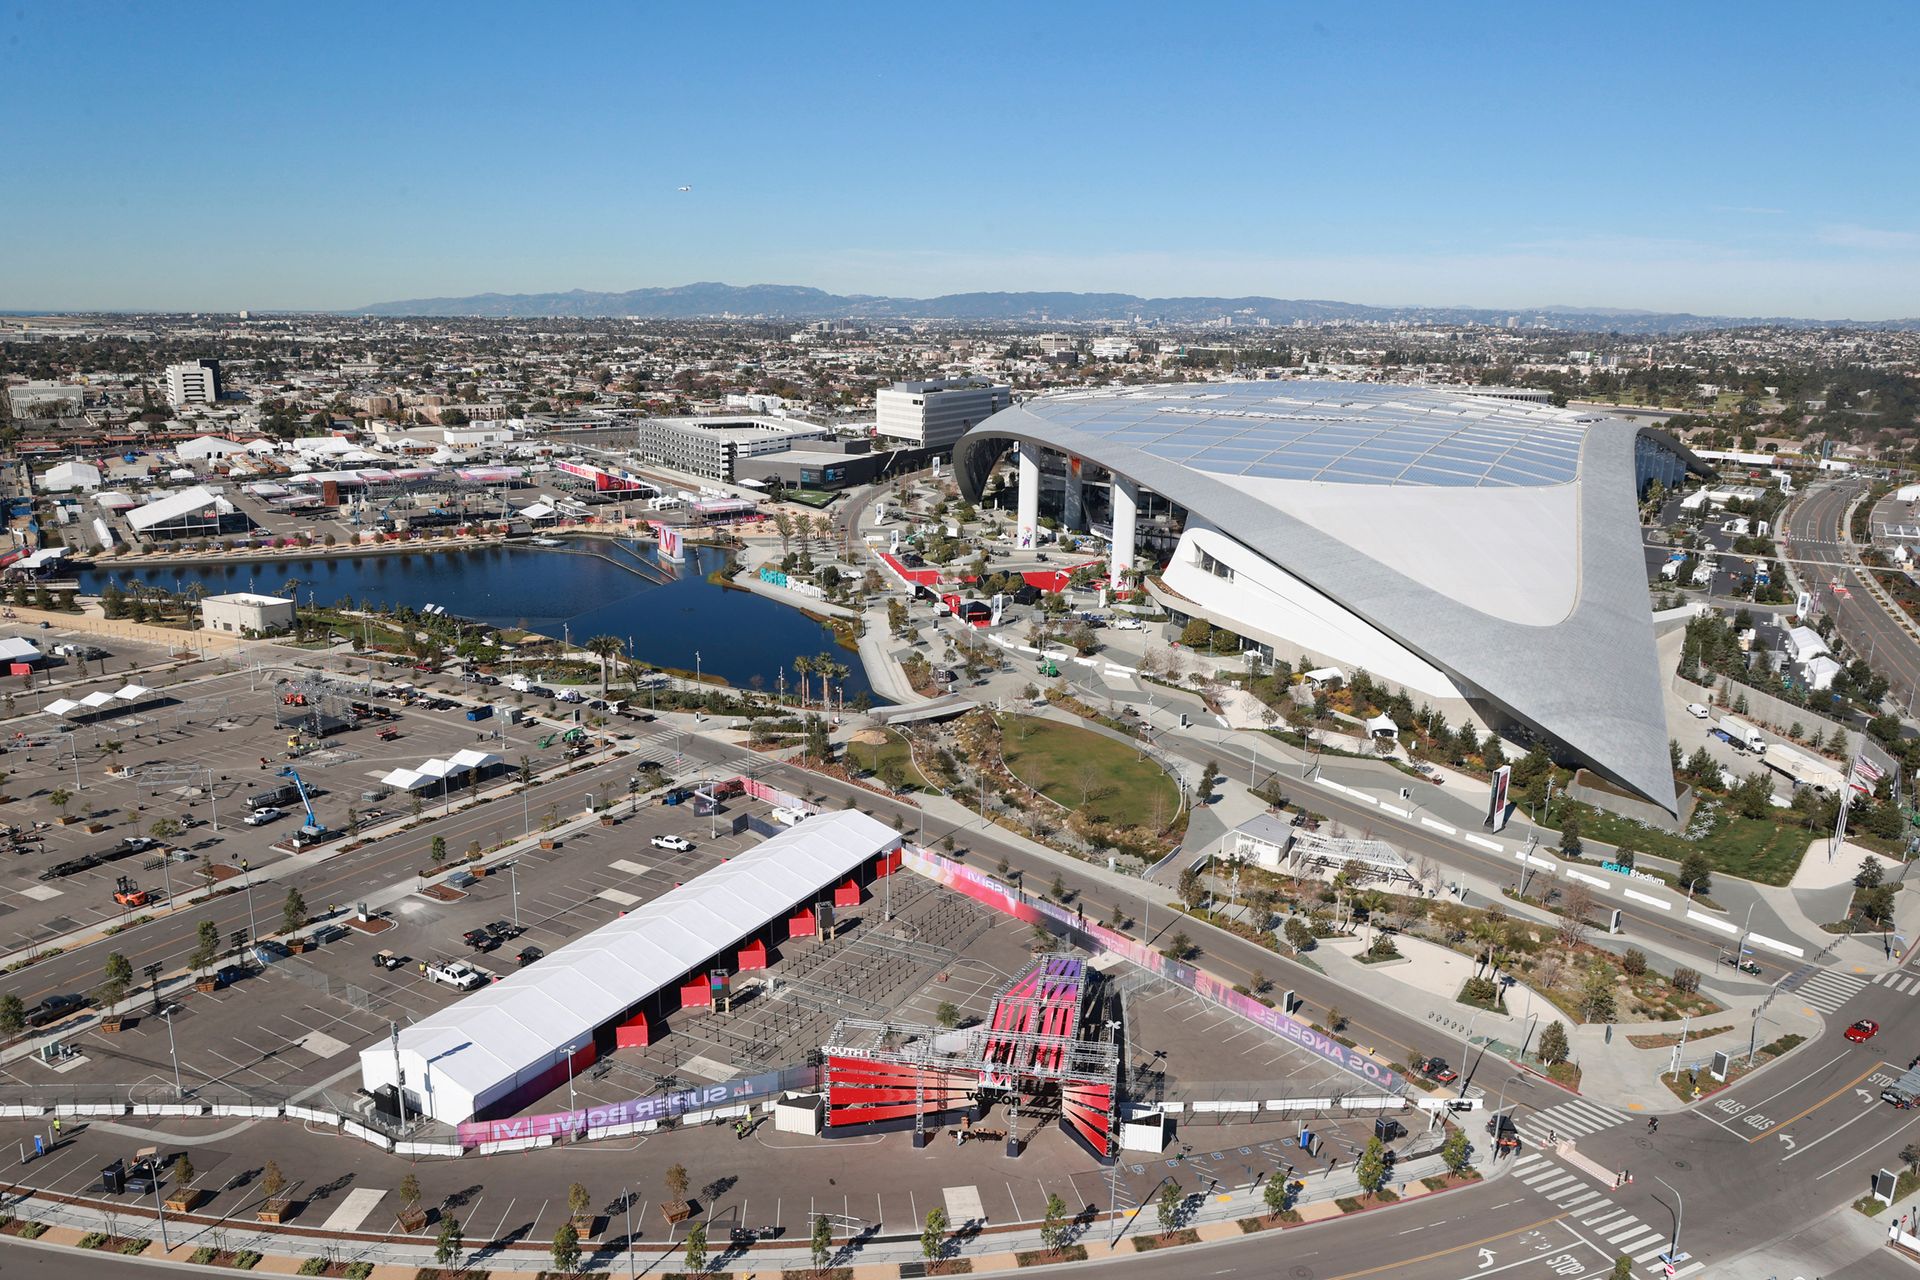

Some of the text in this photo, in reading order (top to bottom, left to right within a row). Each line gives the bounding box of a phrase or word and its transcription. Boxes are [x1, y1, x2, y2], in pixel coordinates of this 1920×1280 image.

[1602, 861, 1665, 887] SoFi Stadium
[821, 1045, 862, 1057] SOUTH
[1714, 1098, 1746, 1114] STOP
[1743, 1113, 1775, 1131] STOP
[1545, 1254, 1586, 1276] STOP
